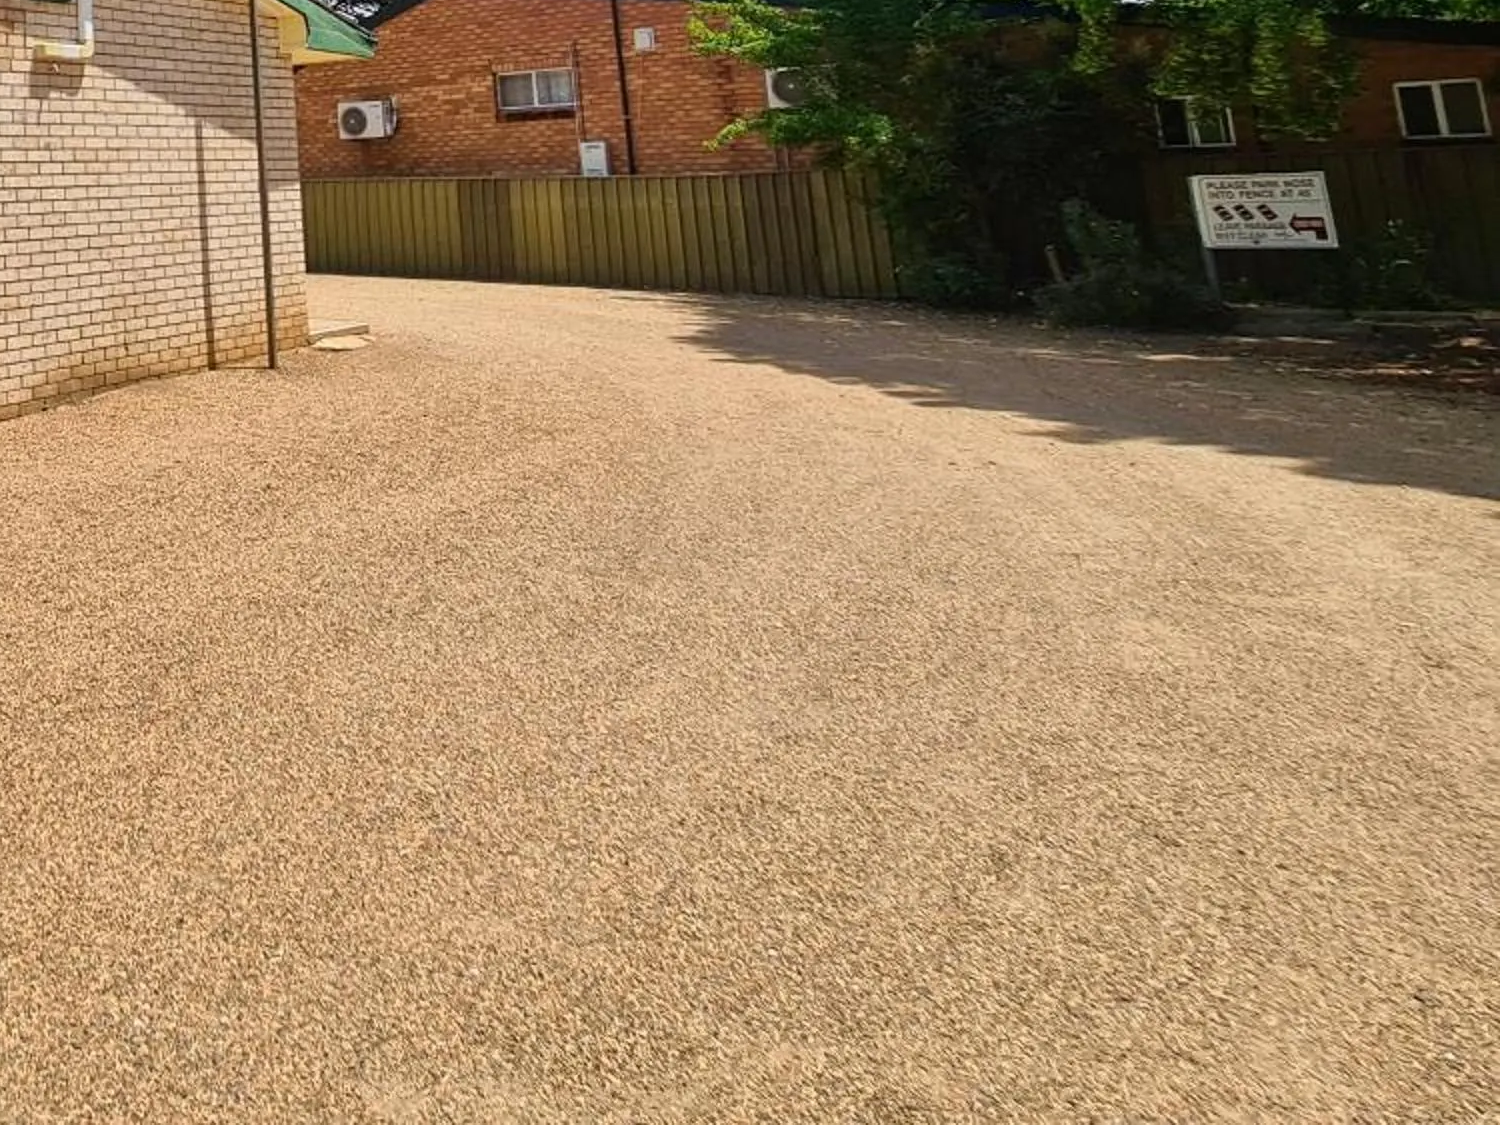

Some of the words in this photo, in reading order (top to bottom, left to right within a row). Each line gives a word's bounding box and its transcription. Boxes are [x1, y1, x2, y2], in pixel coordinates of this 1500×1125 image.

[1206, 180, 1248, 189] PLEASE
[1251, 179, 1280, 188] PARK
[1283, 178, 1315, 187] NOSE
[1208, 191, 1234, 199] INTO
[1239, 190, 1274, 199] FENCE
[1280, 189, 1293, 197] AT
